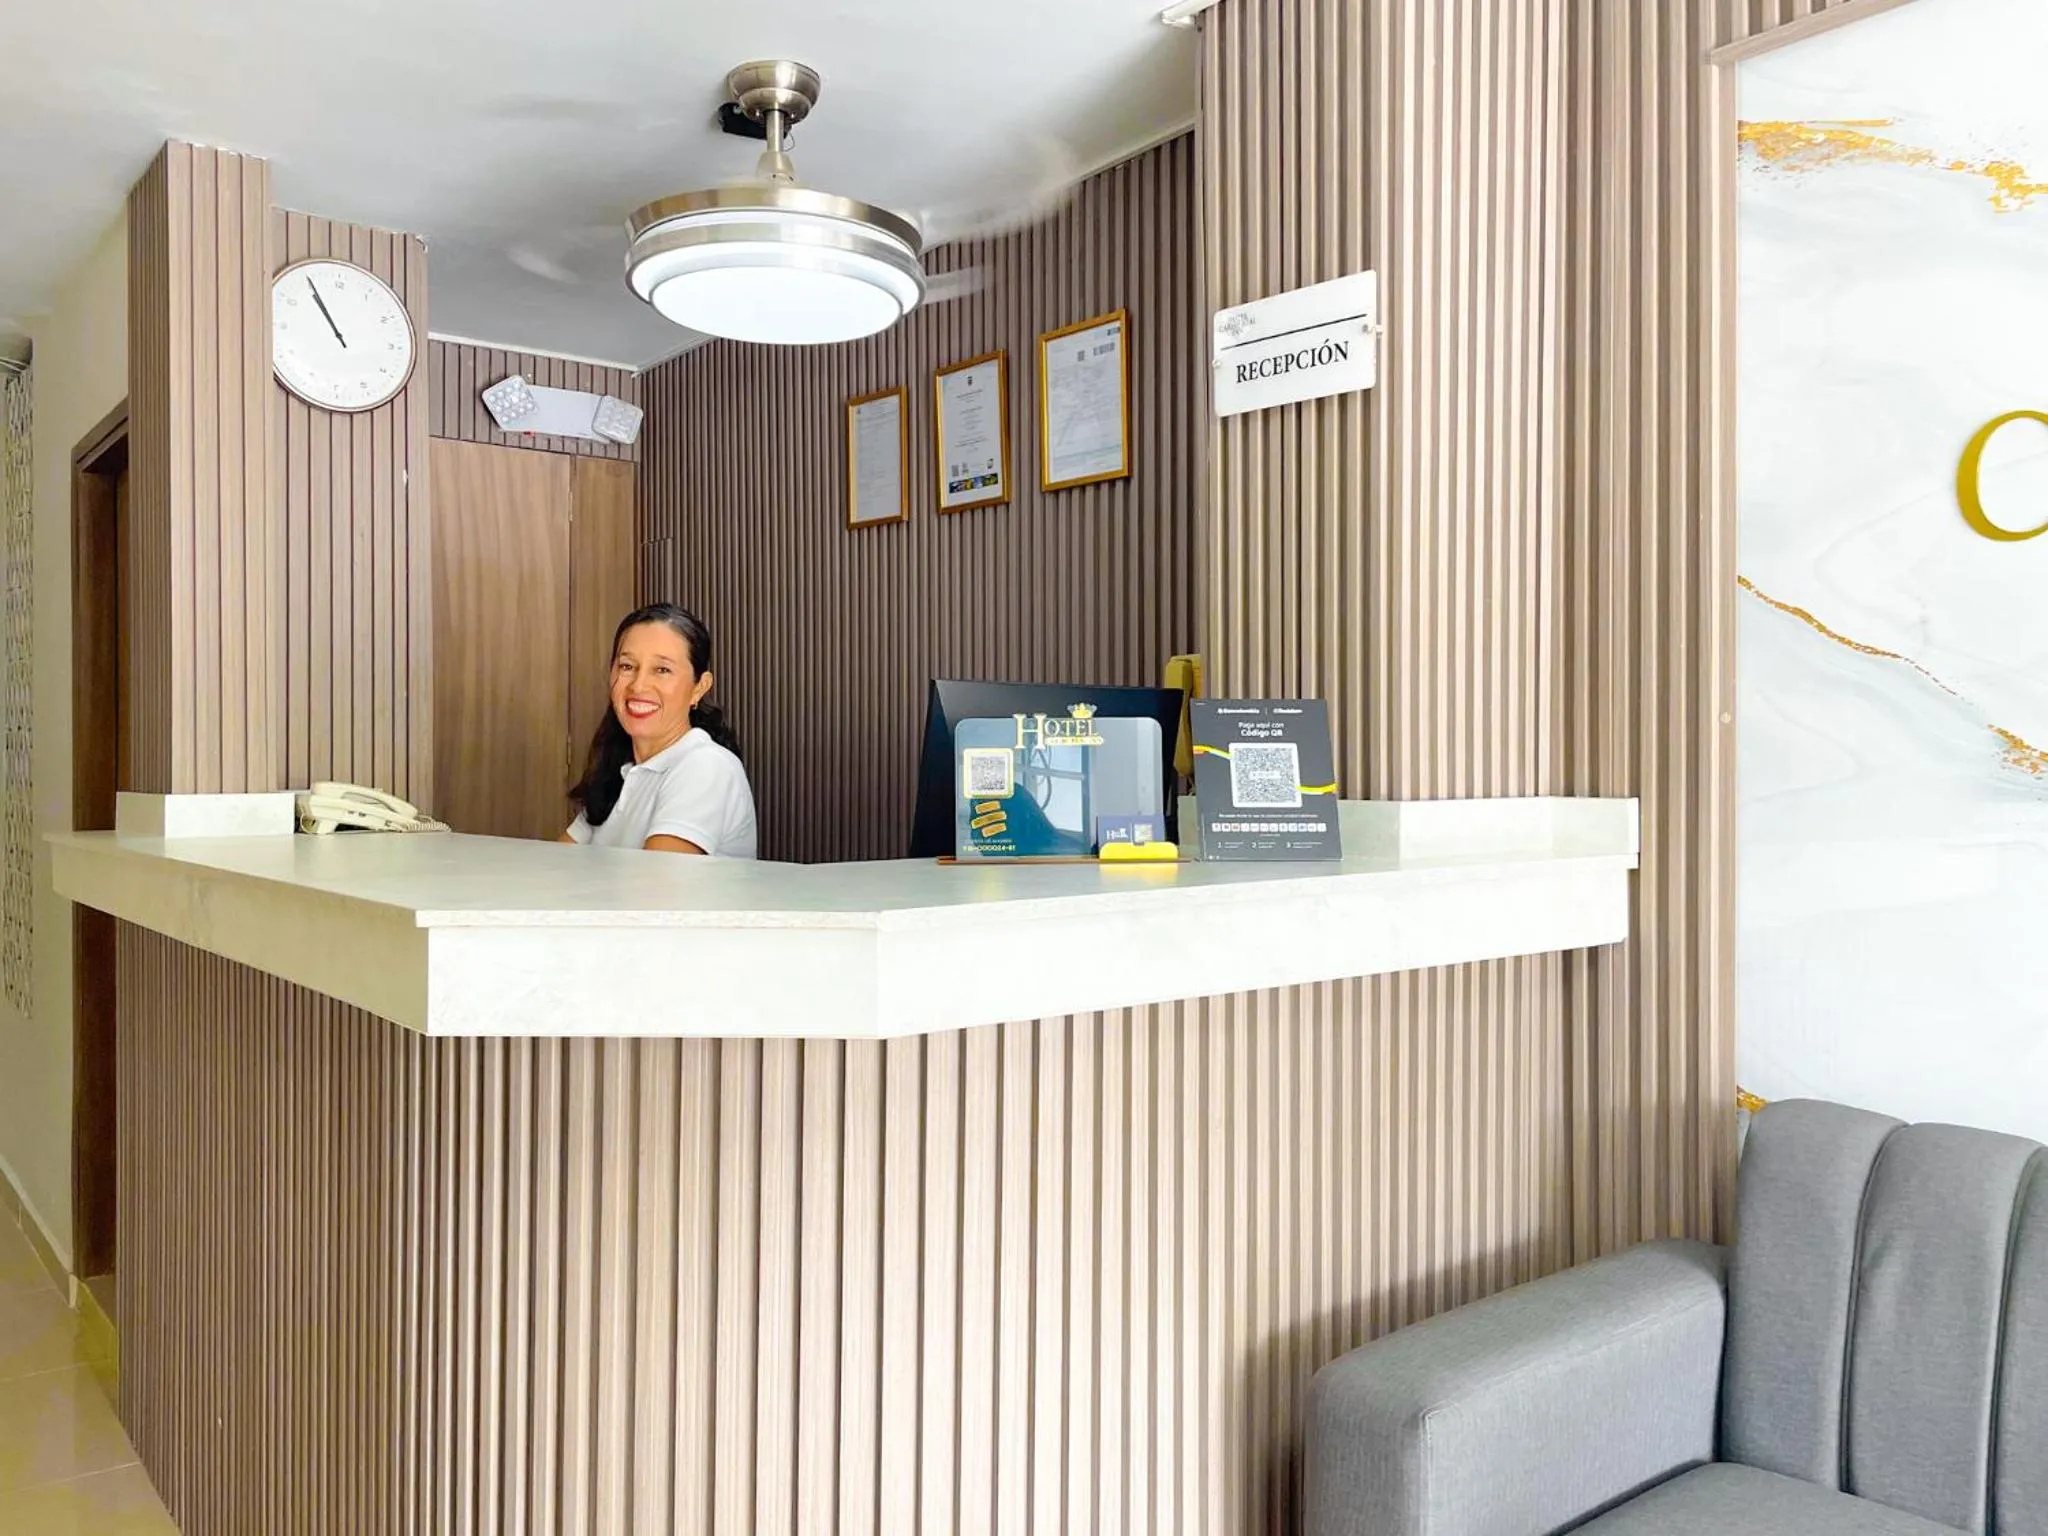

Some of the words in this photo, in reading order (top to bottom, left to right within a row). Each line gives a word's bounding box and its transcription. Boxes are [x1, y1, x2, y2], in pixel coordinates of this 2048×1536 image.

[1236, 338, 1349, 384] RECEPCIÓN
[1012, 713, 1100, 749] HOTEL
[1240, 728, 1270, 738] Código
[1271, 729, 1283, 737] QR
